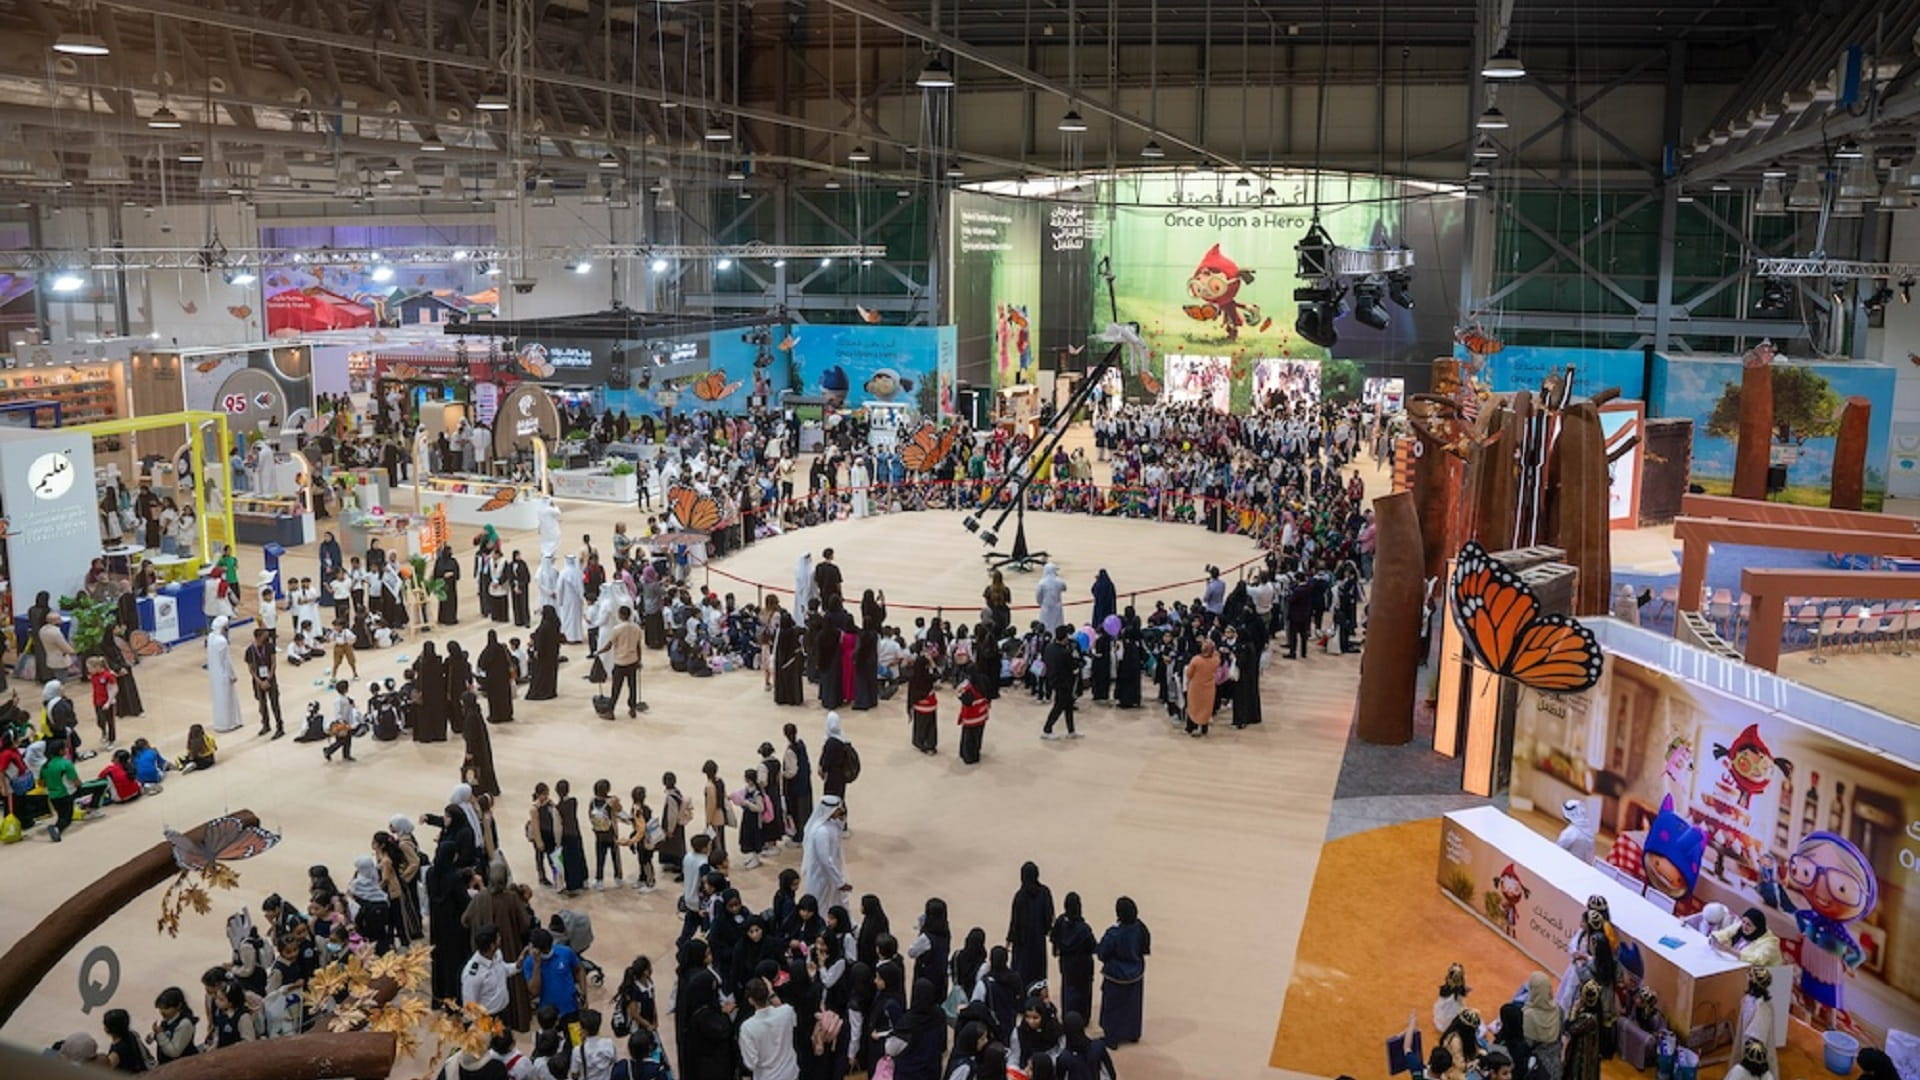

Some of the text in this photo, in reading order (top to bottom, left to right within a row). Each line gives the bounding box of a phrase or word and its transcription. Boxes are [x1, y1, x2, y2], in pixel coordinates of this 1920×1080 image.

[1164, 212, 1305, 231] Once Upon a Hero
[1529, 918, 1551, 939] Once
